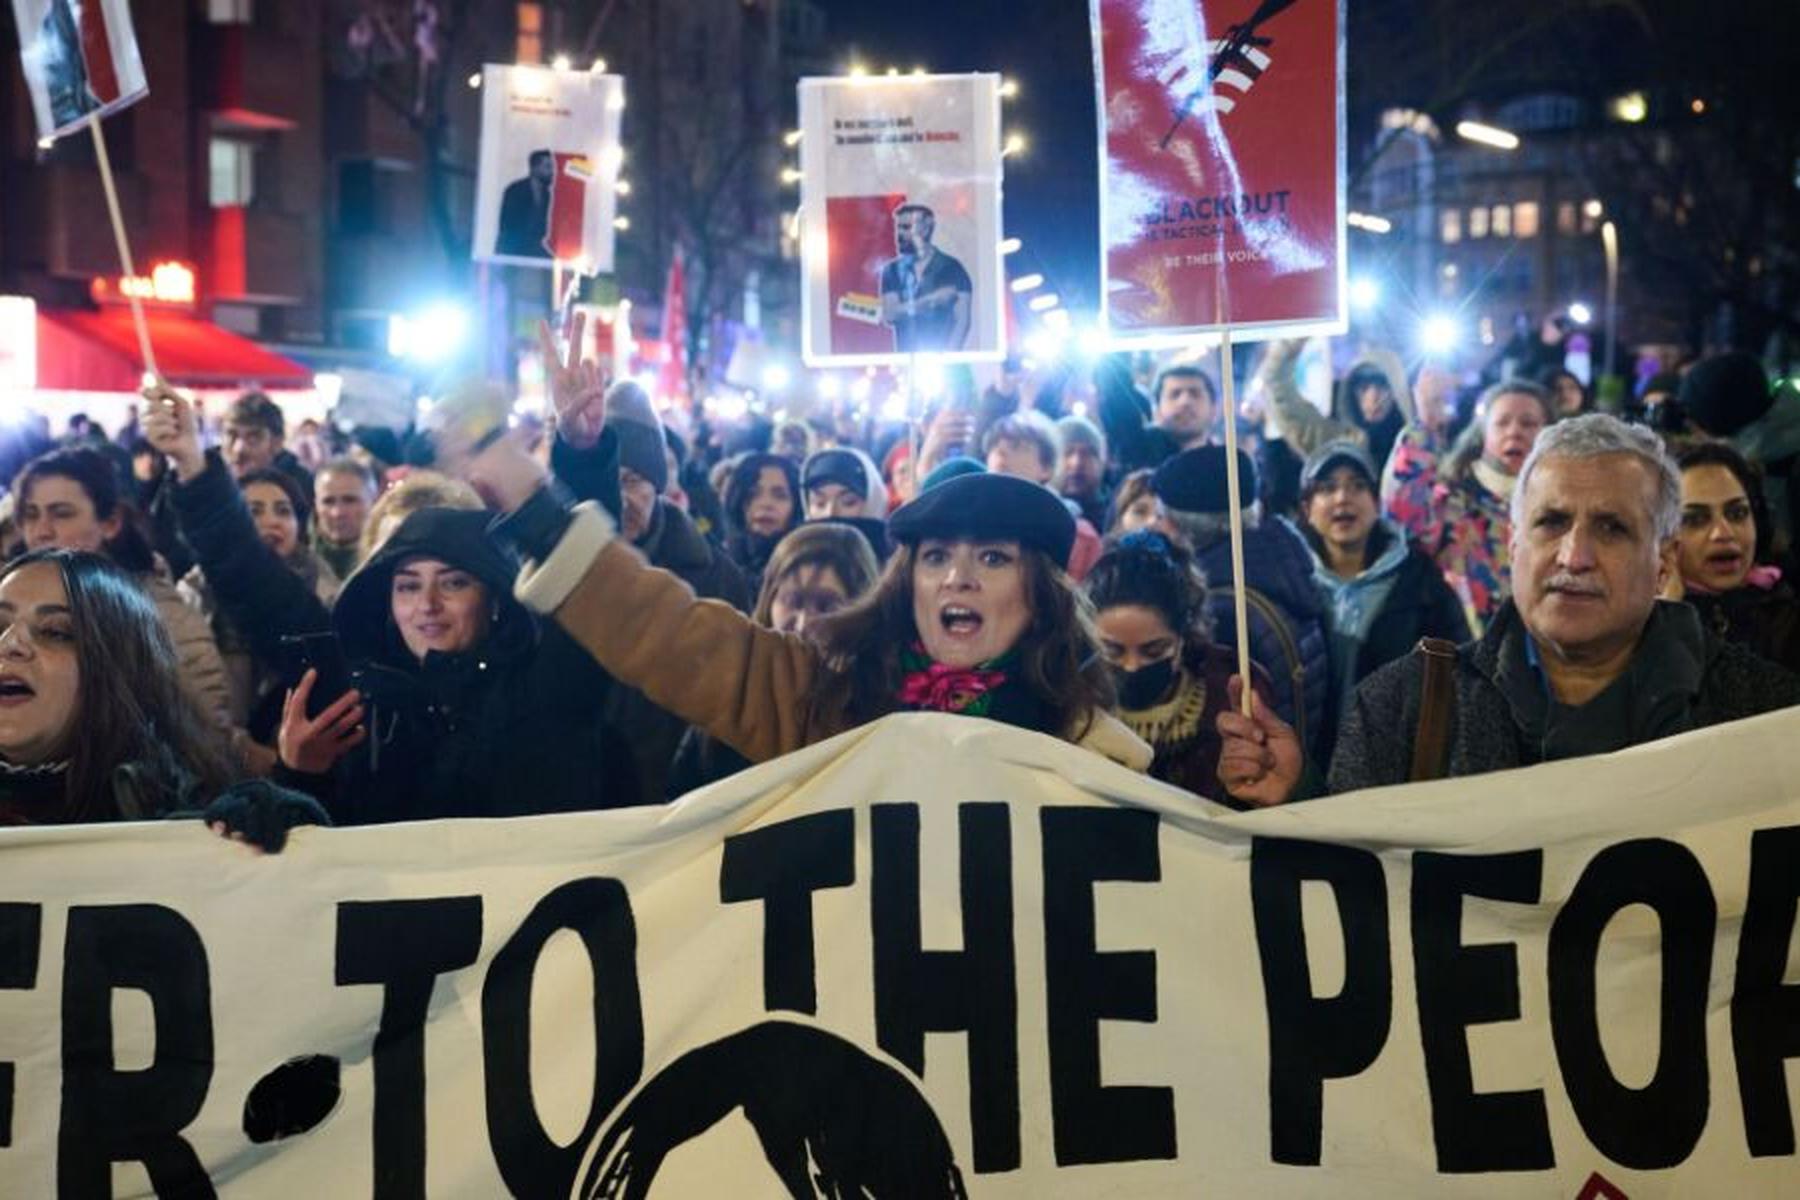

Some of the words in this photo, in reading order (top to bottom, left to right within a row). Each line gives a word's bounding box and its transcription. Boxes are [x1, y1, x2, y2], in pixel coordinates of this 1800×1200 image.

[1145, 190, 1290, 224] BLACKOUT
[335, 877, 645, 1200] TO
[720, 802, 1178, 1174] THE
